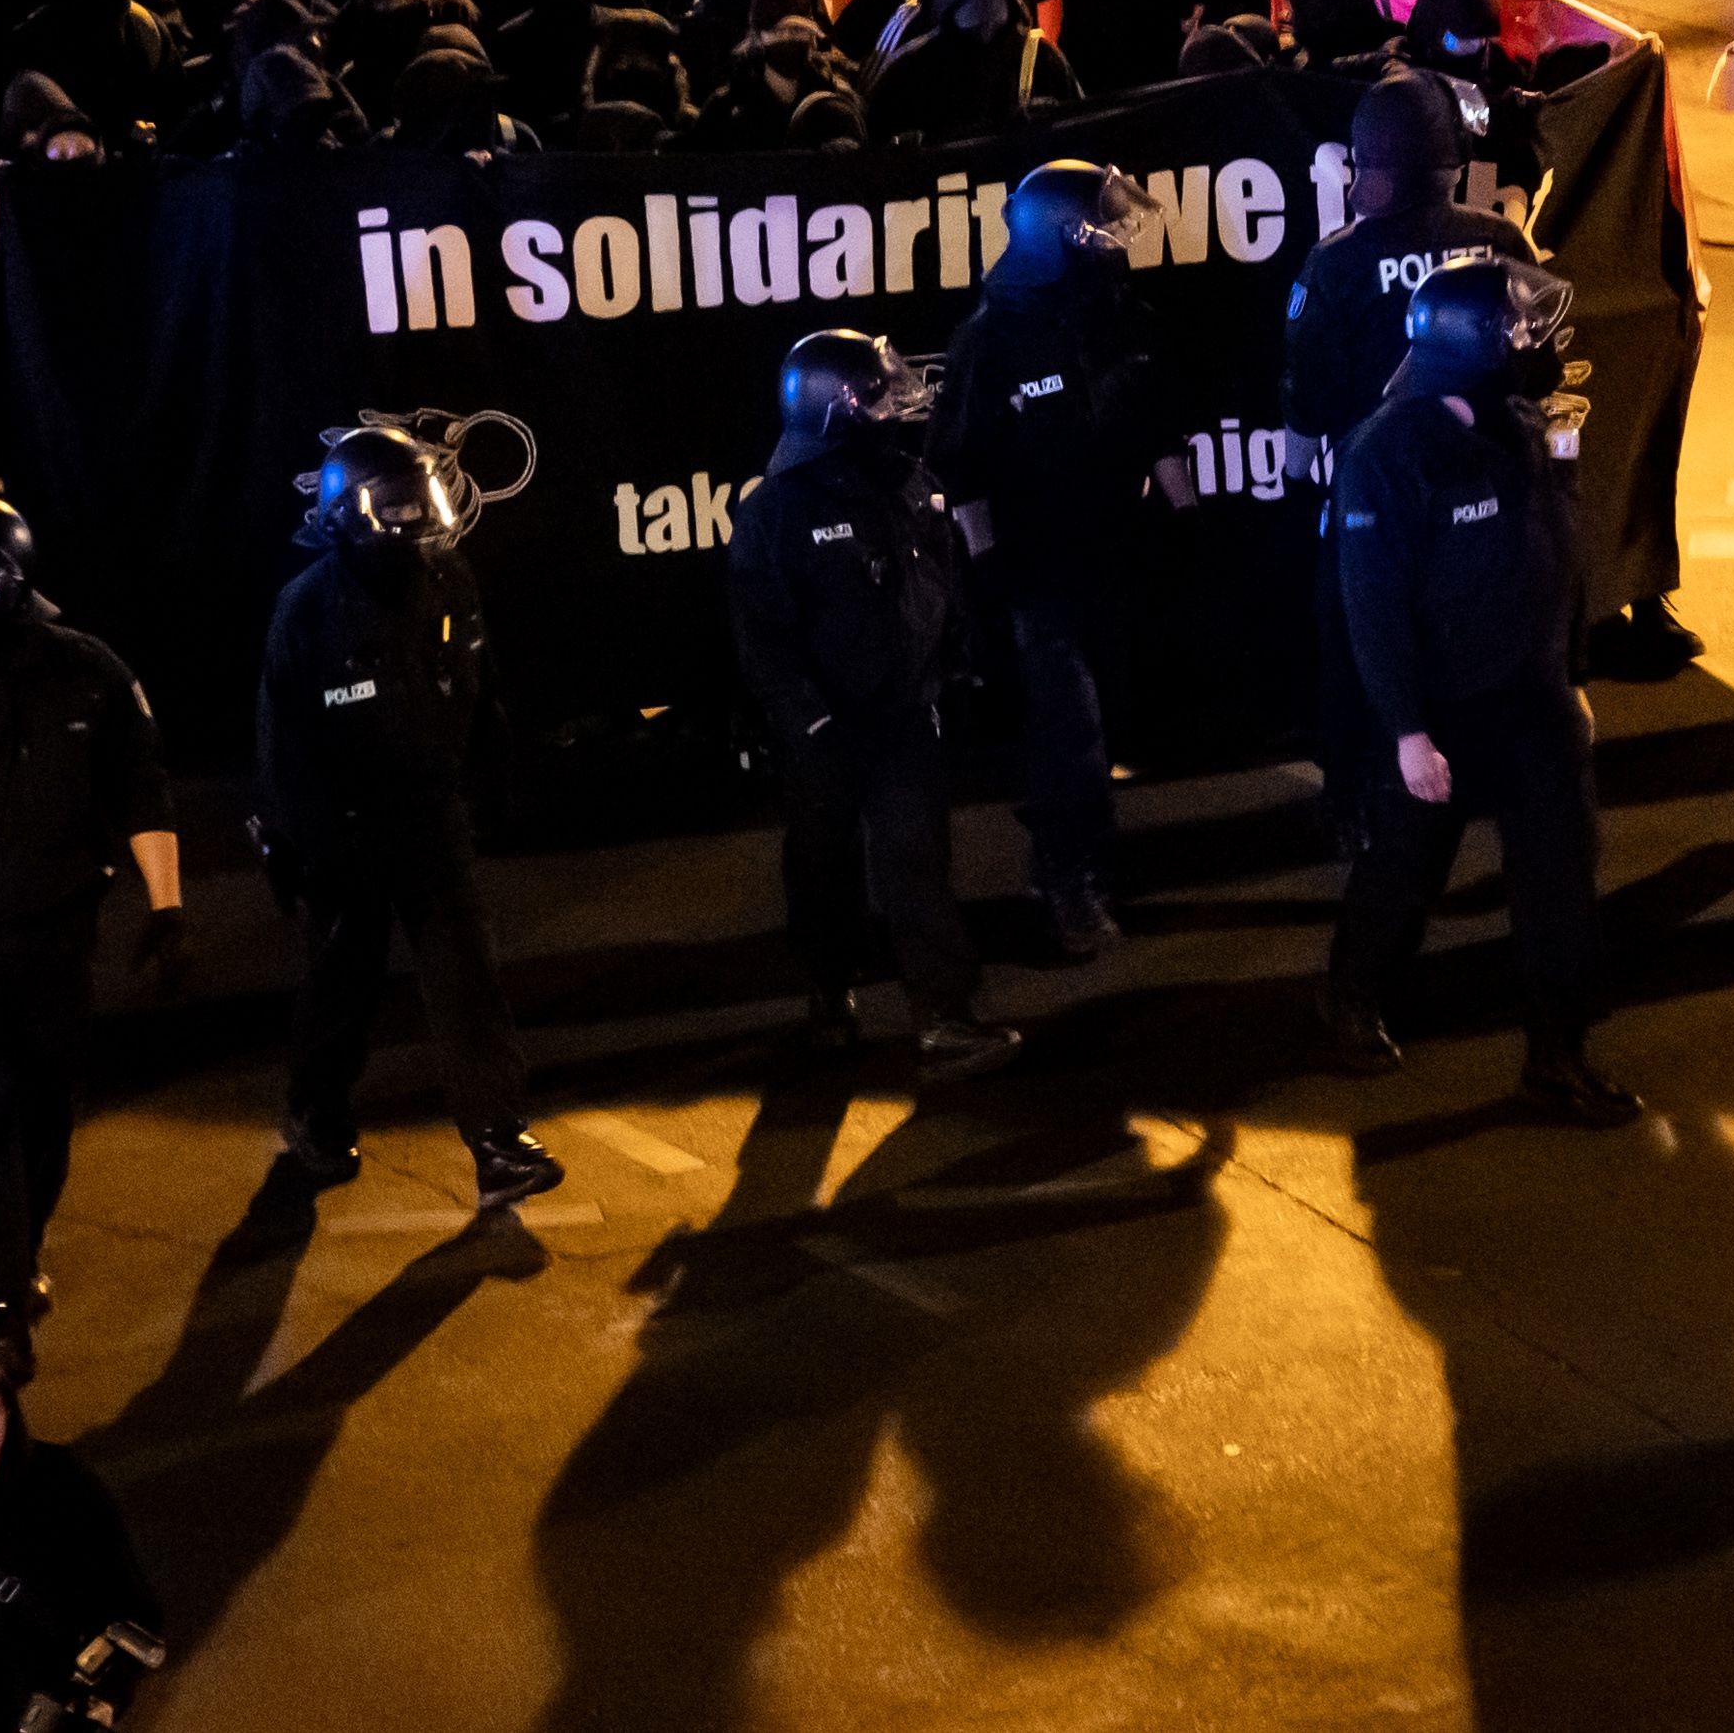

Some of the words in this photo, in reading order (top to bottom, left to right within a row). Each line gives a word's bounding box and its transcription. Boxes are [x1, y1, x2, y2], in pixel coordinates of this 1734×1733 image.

[357, 205, 476, 335] in
[500, 171, 1012, 324] solidarit
[1186, 416, 1335, 502] nig
[614, 470, 767, 557] tak
[323, 680, 378, 710] POLIZEI
